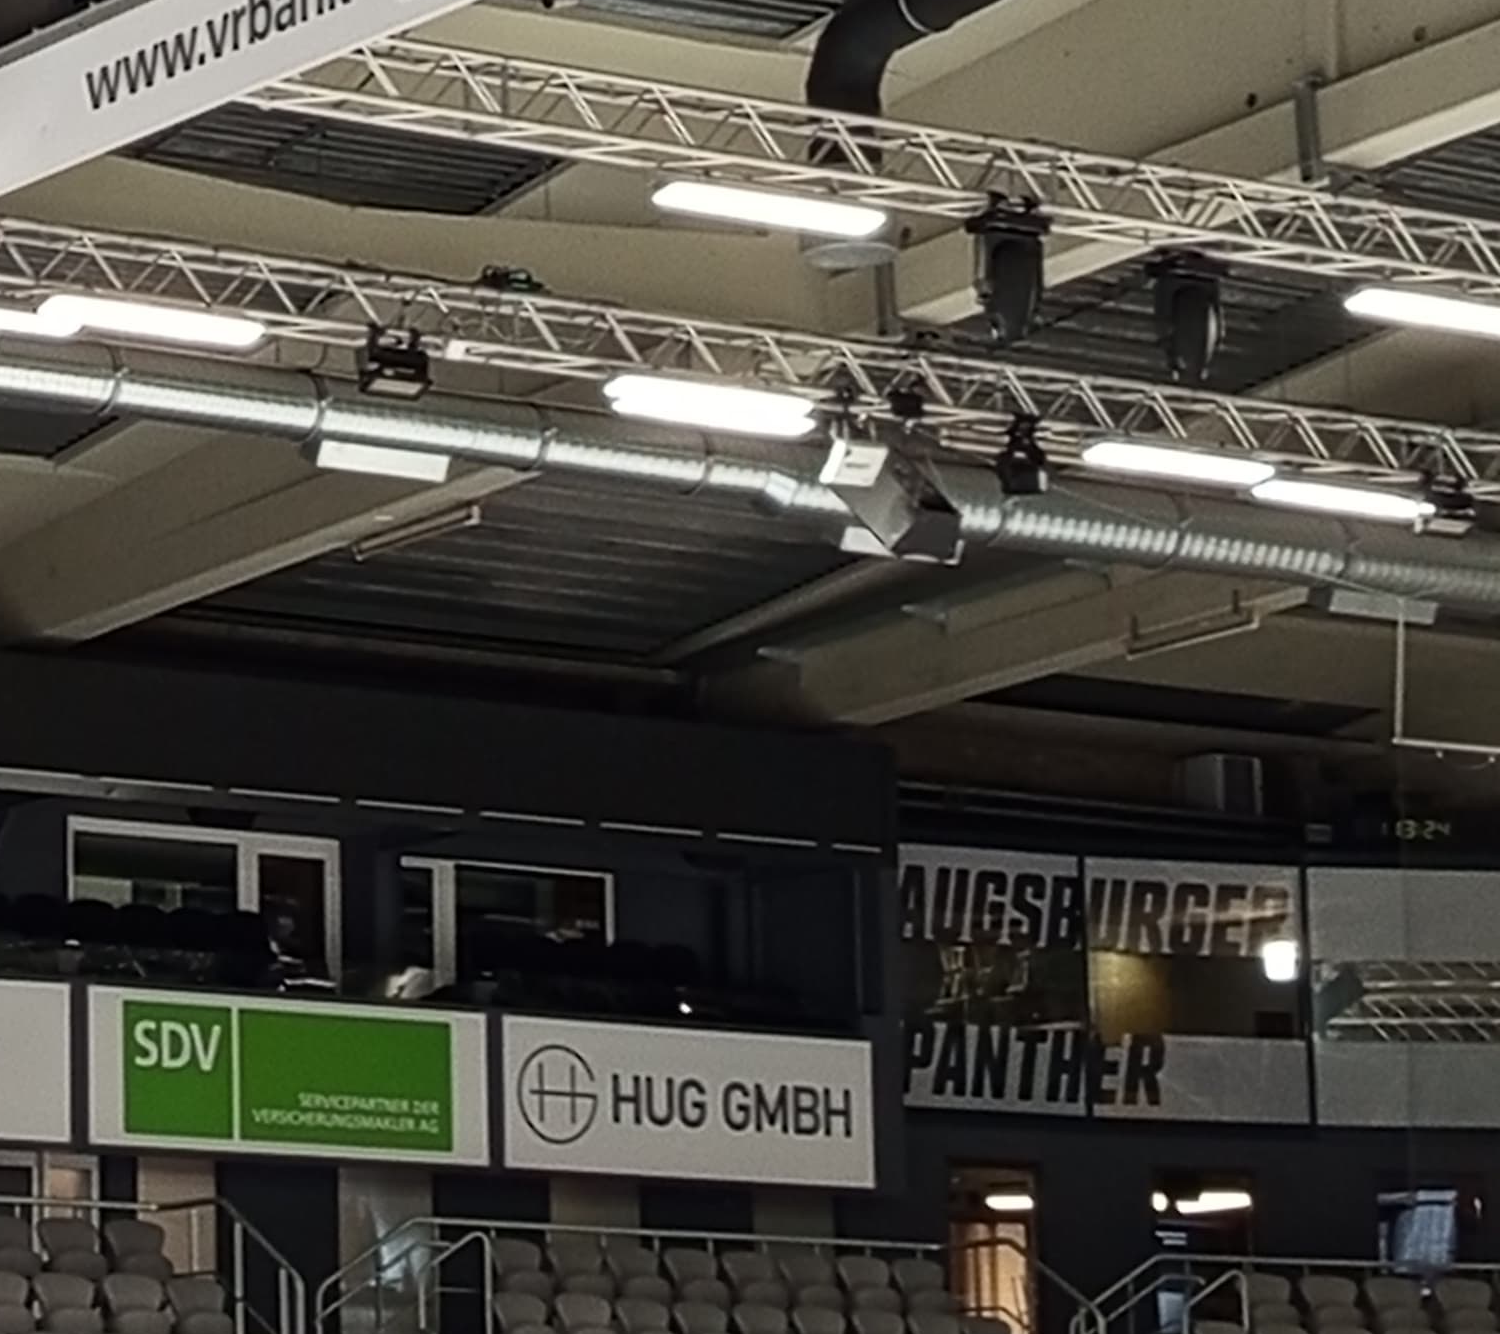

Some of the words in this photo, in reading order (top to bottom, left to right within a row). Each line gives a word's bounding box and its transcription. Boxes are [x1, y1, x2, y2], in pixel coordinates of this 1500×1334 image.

[900, 864, 1292, 958] AUGSBURGER
[133, 1020, 222, 1072] SDV
[901, 1019, 1166, 1107] PANTHER
[611, 1073, 708, 1128] HUG
[722, 1081, 853, 1138] GMBH
